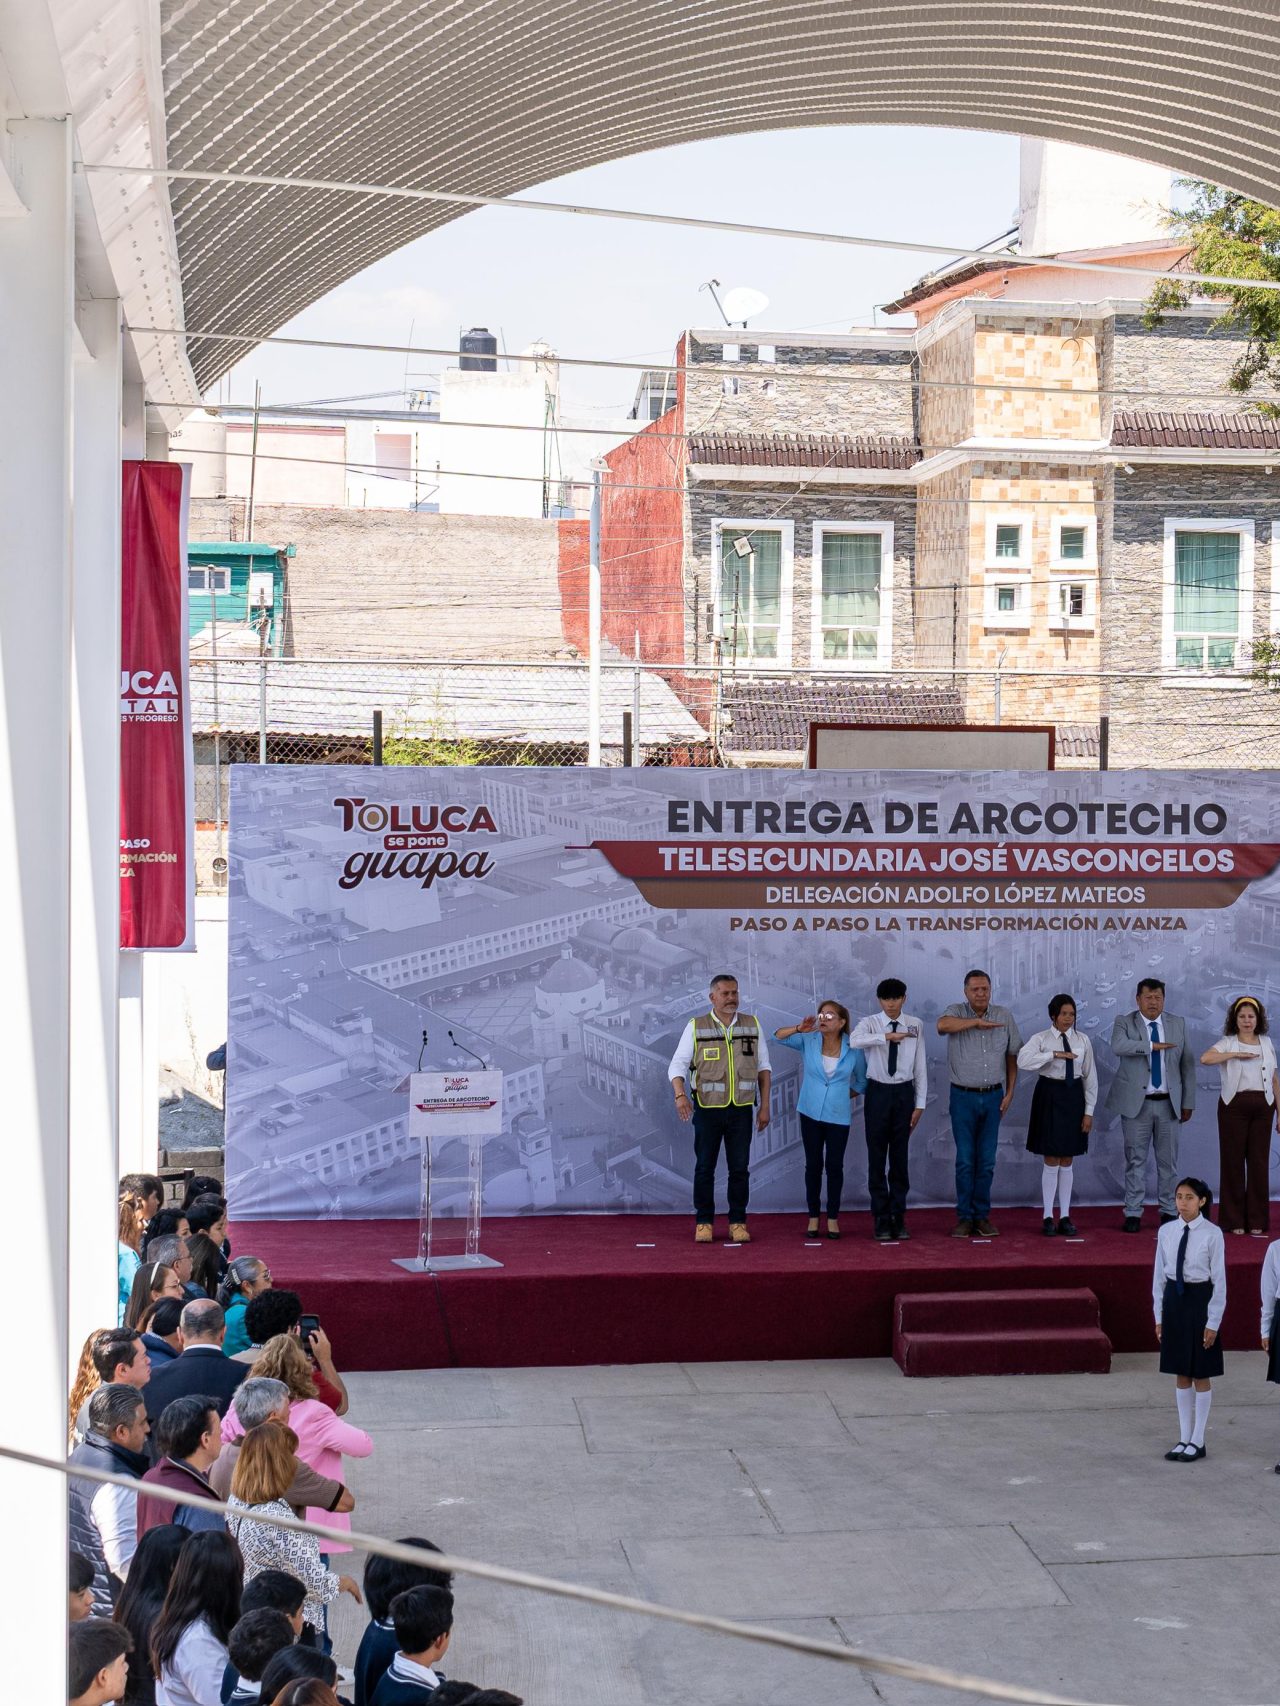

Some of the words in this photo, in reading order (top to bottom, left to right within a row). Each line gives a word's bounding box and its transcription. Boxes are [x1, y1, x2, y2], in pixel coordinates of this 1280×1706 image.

[334, 798, 498, 832] TOLUCA
[668, 800, 874, 834] ENTREGA
[885, 802, 938, 834] DE
[948, 802, 1227, 835] ARCOTECHO
[388, 837, 404, 846] se
[408, 835, 446, 848] pone
[338, 851, 496, 889] guapa
[658, 847, 926, 872] TELESECUNDARIA
[929, 842, 1008, 872] JOSÉ
[1012, 848, 1235, 872] VASCONCELOS
[766, 882, 900, 903] DELEGACIÓN
[904, 886, 989, 903] ADOLFO
[994, 882, 1057, 903] LÓPEZ
[1061, 886, 1146, 903] MATEOS
[730, 917, 787, 931] PASO
[792, 917, 807, 931] A
[812, 917, 869, 931] PASO
[875, 917, 901, 931] LA
[906, 913, 1098, 931] TRANSFORMACIÓN
[1103, 916, 1187, 931] AVANZA
